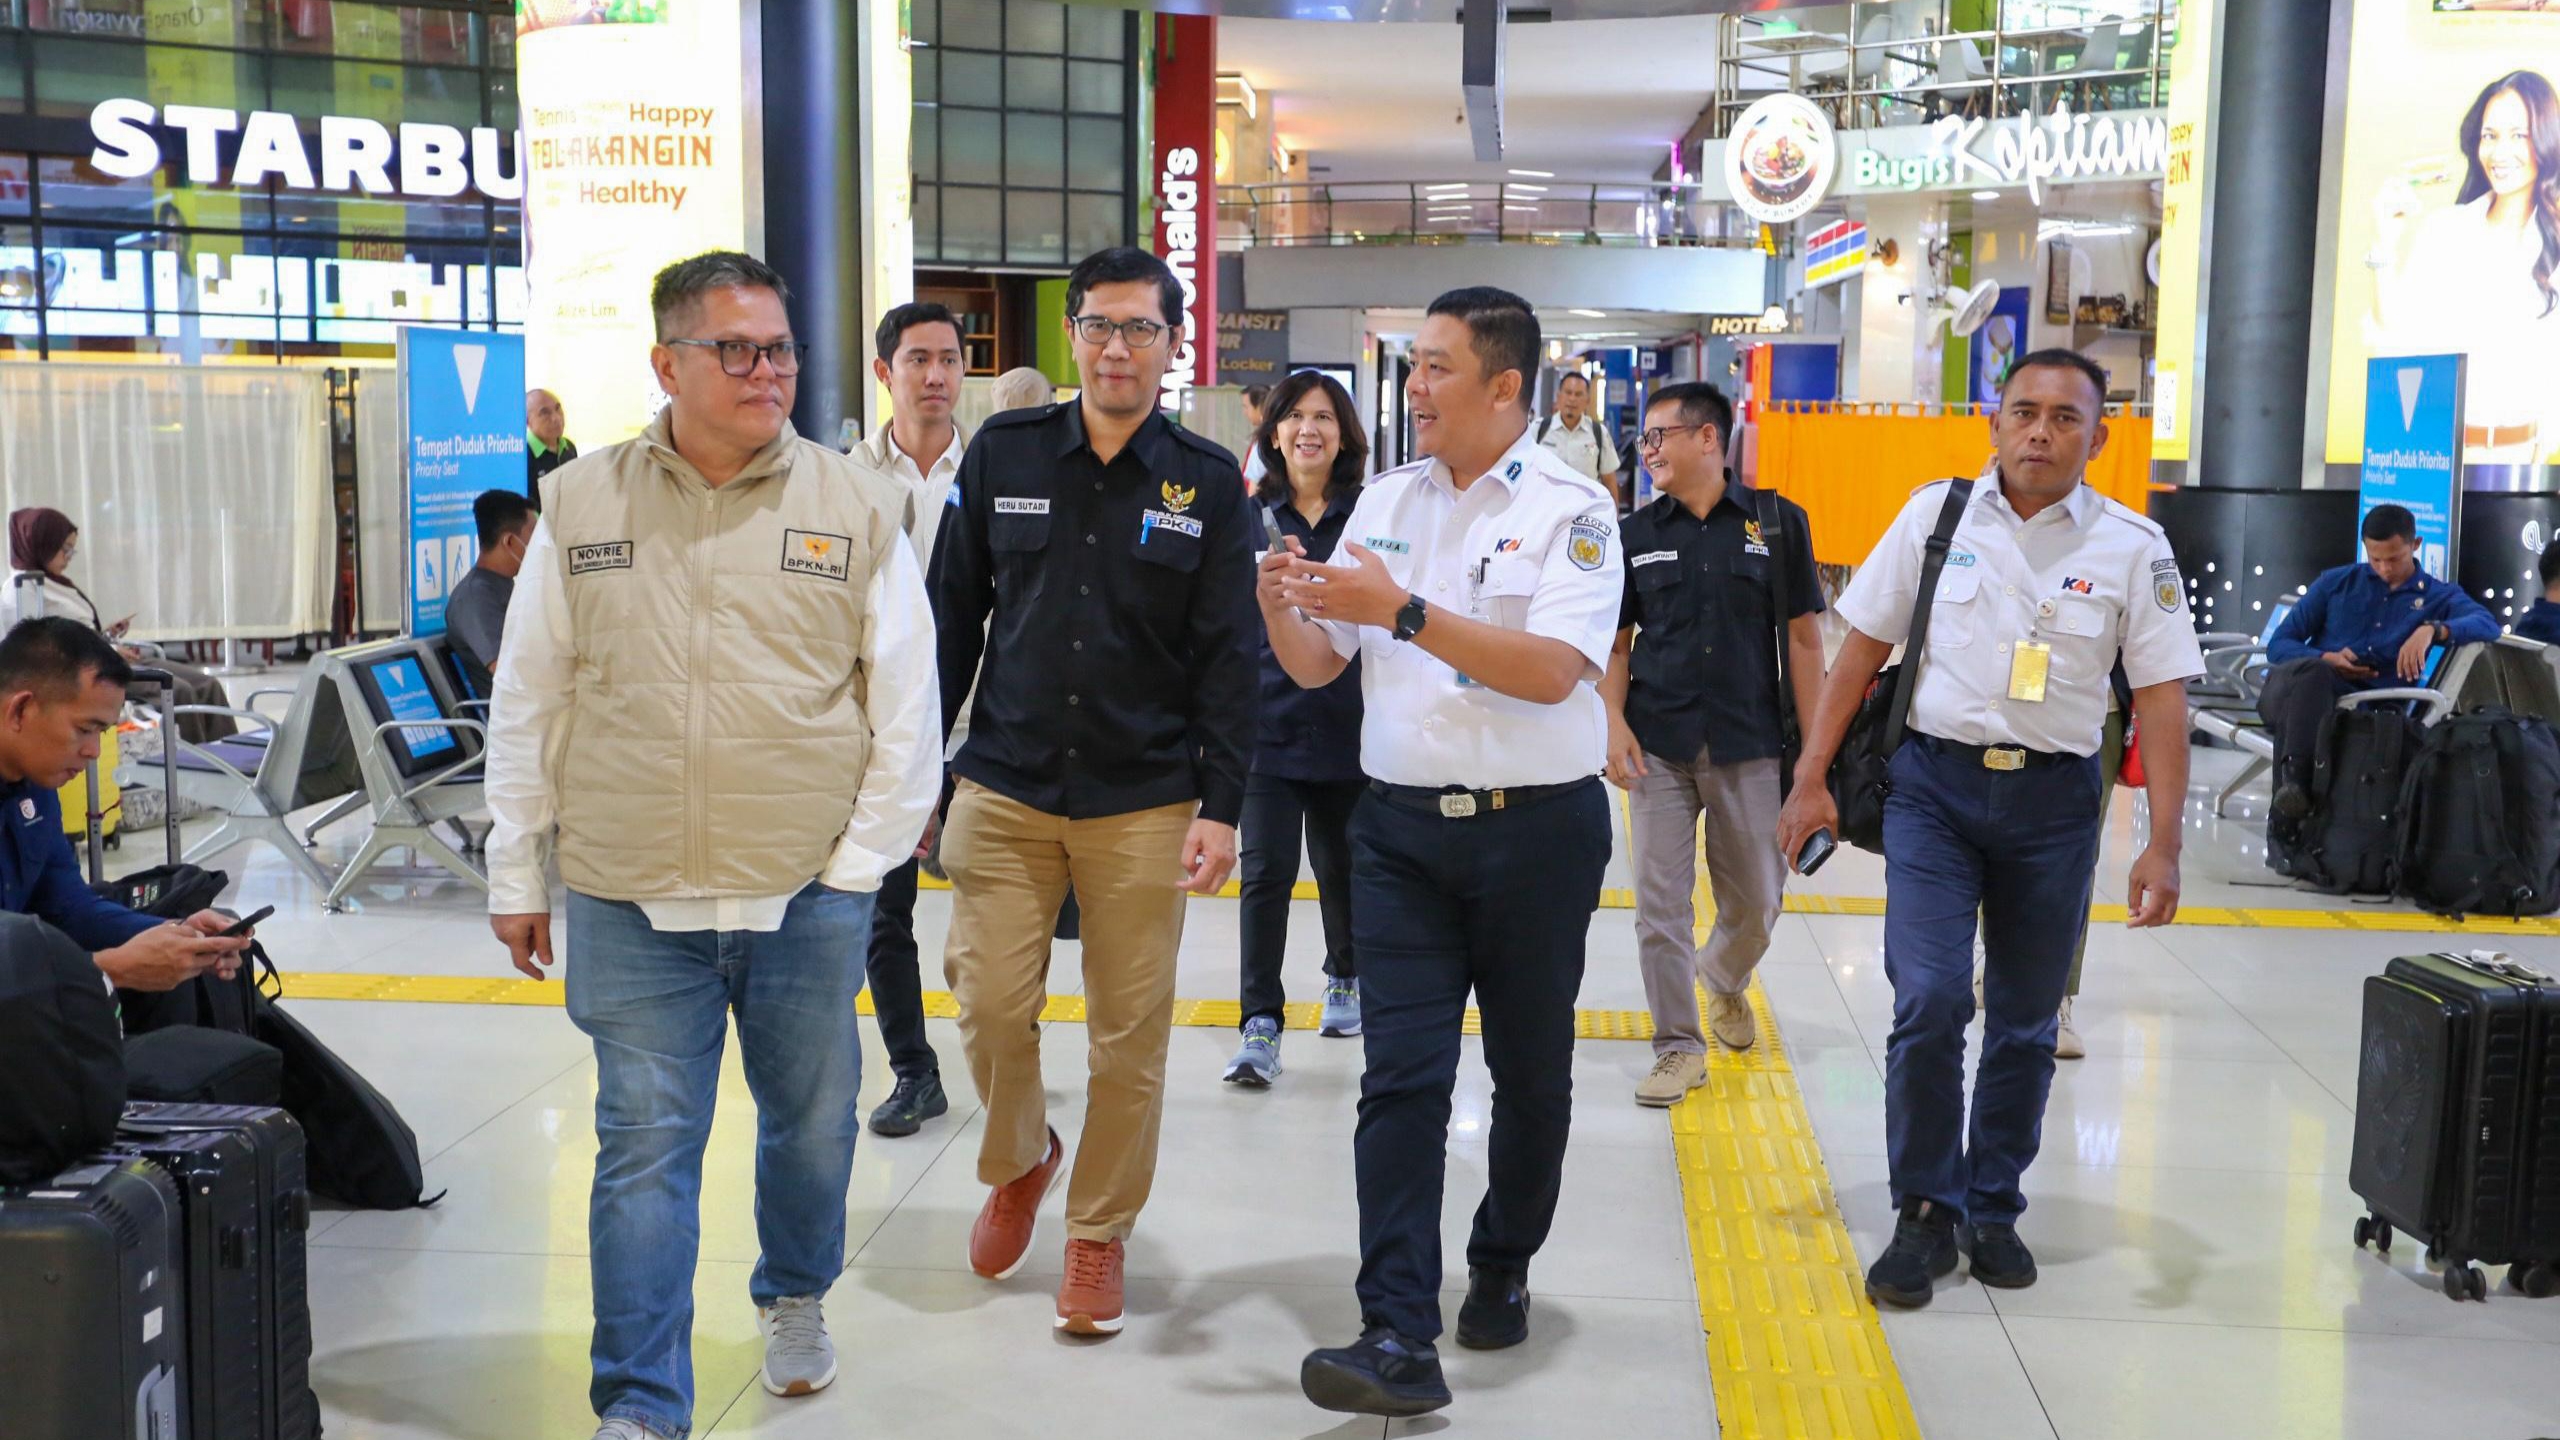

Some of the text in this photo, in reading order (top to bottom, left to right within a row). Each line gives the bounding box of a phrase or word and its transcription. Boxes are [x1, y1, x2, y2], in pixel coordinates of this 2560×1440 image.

[629, 102, 714, 128] Happy
[89, 97, 522, 199] STARBU
[1853, 148, 1950, 191] Bugis
[579, 179, 688, 211] Healthy
[1220, 356, 1275, 372] Locker
[415, 432, 524, 461] Tempat Duduk Prioritas
[415, 459, 460, 480] Priority Seat
[2366, 447, 2450, 471] Tempat Duduk Prioritas
[997, 501, 1046, 511] HERU SUTADI
[577, 545, 623, 561] NOVRIE
[1371, 539, 1401, 551] RAJA
[786, 557, 843, 575] BPKN-RI
